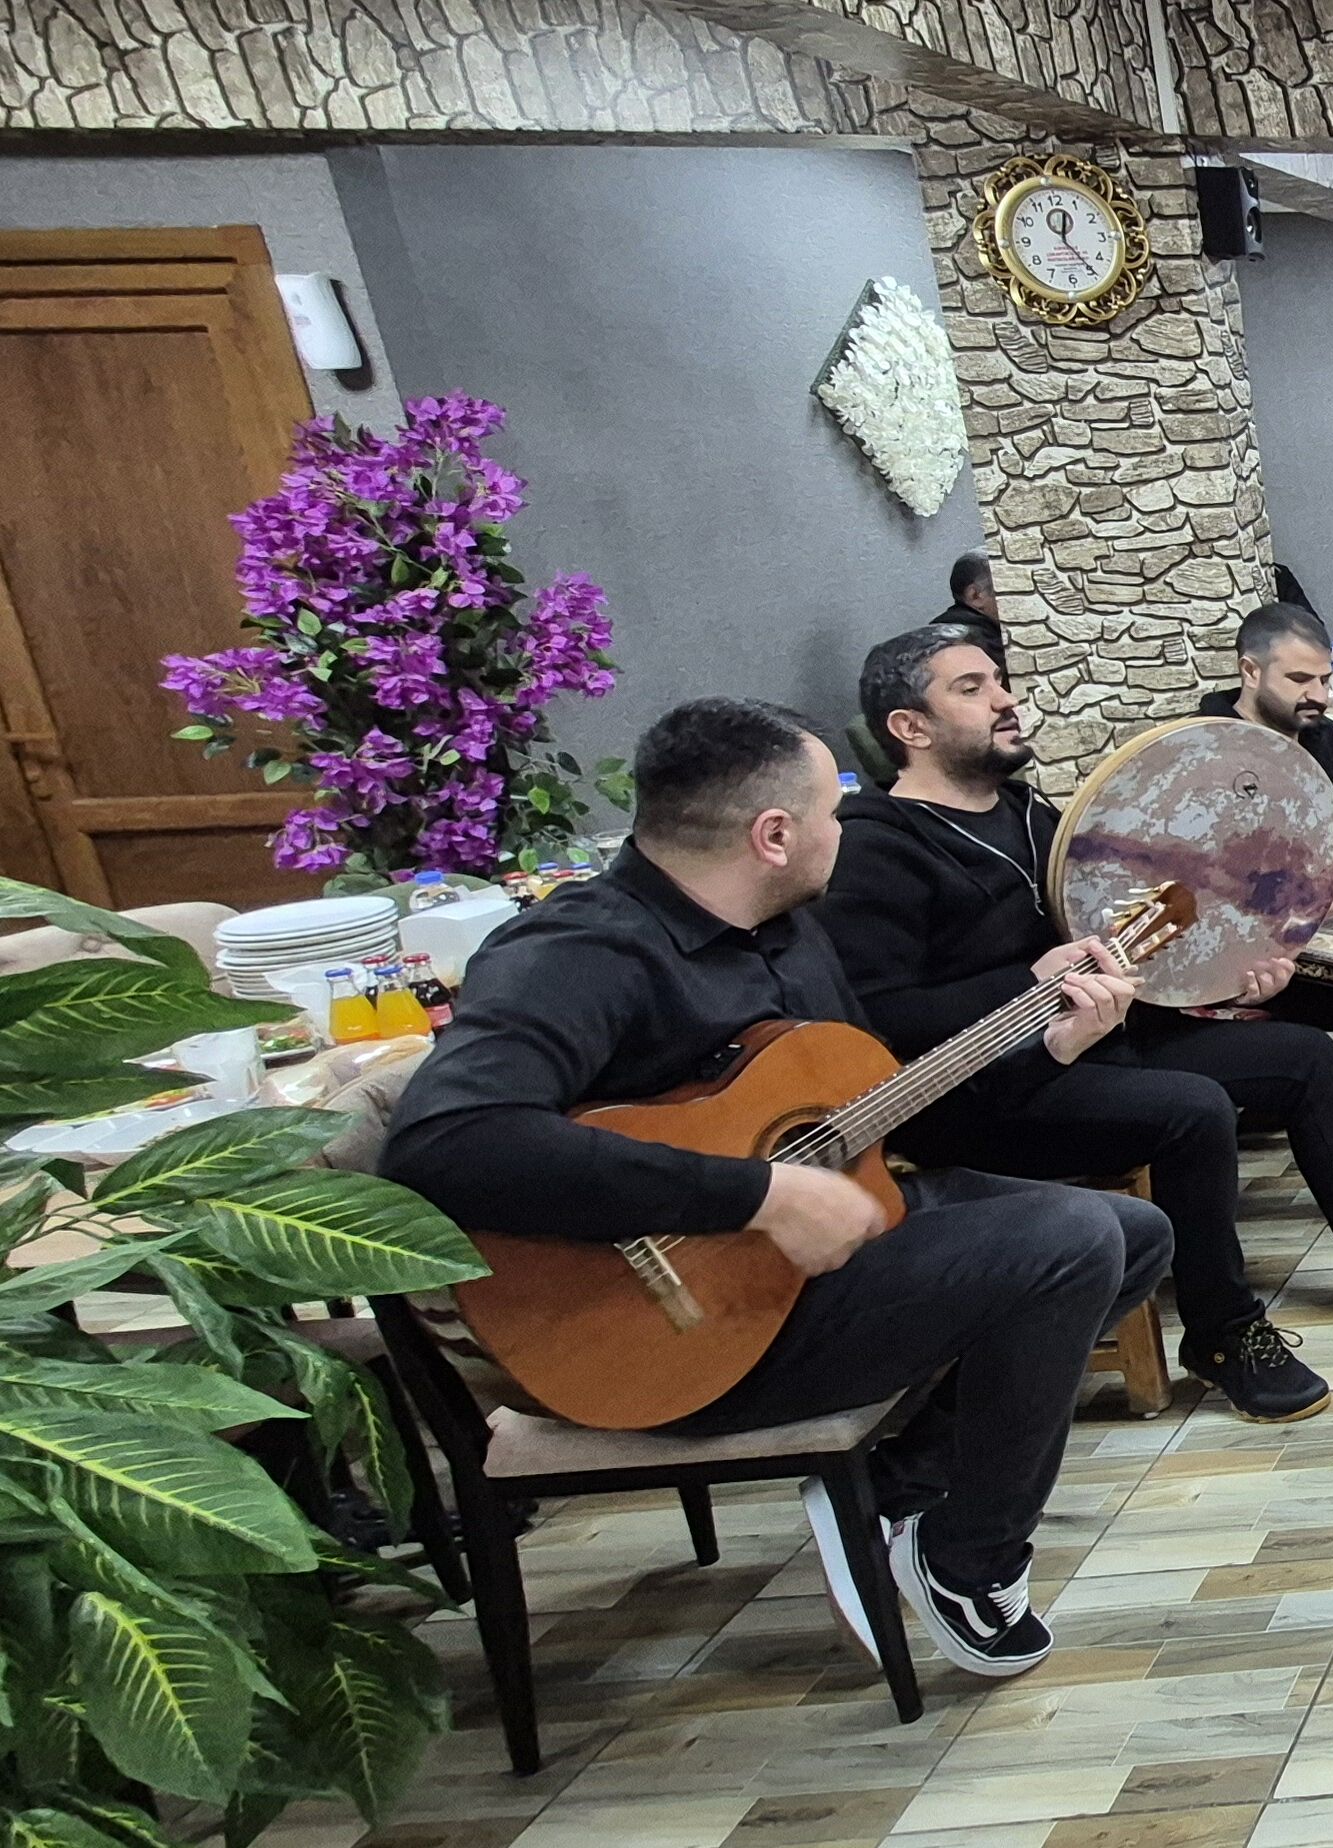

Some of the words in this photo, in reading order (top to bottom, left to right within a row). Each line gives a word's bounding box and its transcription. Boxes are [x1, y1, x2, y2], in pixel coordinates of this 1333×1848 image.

[1047, 195, 1064, 206] 12
[1071, 199, 1078, 211] 1
[1031, 201, 1044, 213] 11
[1021, 216, 1034, 228] 10
[1086, 212, 1097, 224] 2
[1020, 236, 1031, 248] 9
[1096, 232, 1107, 243] 3
[1032, 254, 1042, 265] 8
[1095, 251, 1104, 261] 4
[1046, 268, 1056, 279] 7
[1086, 265, 1097, 276] 5
[1068, 273, 1078, 285] 6
